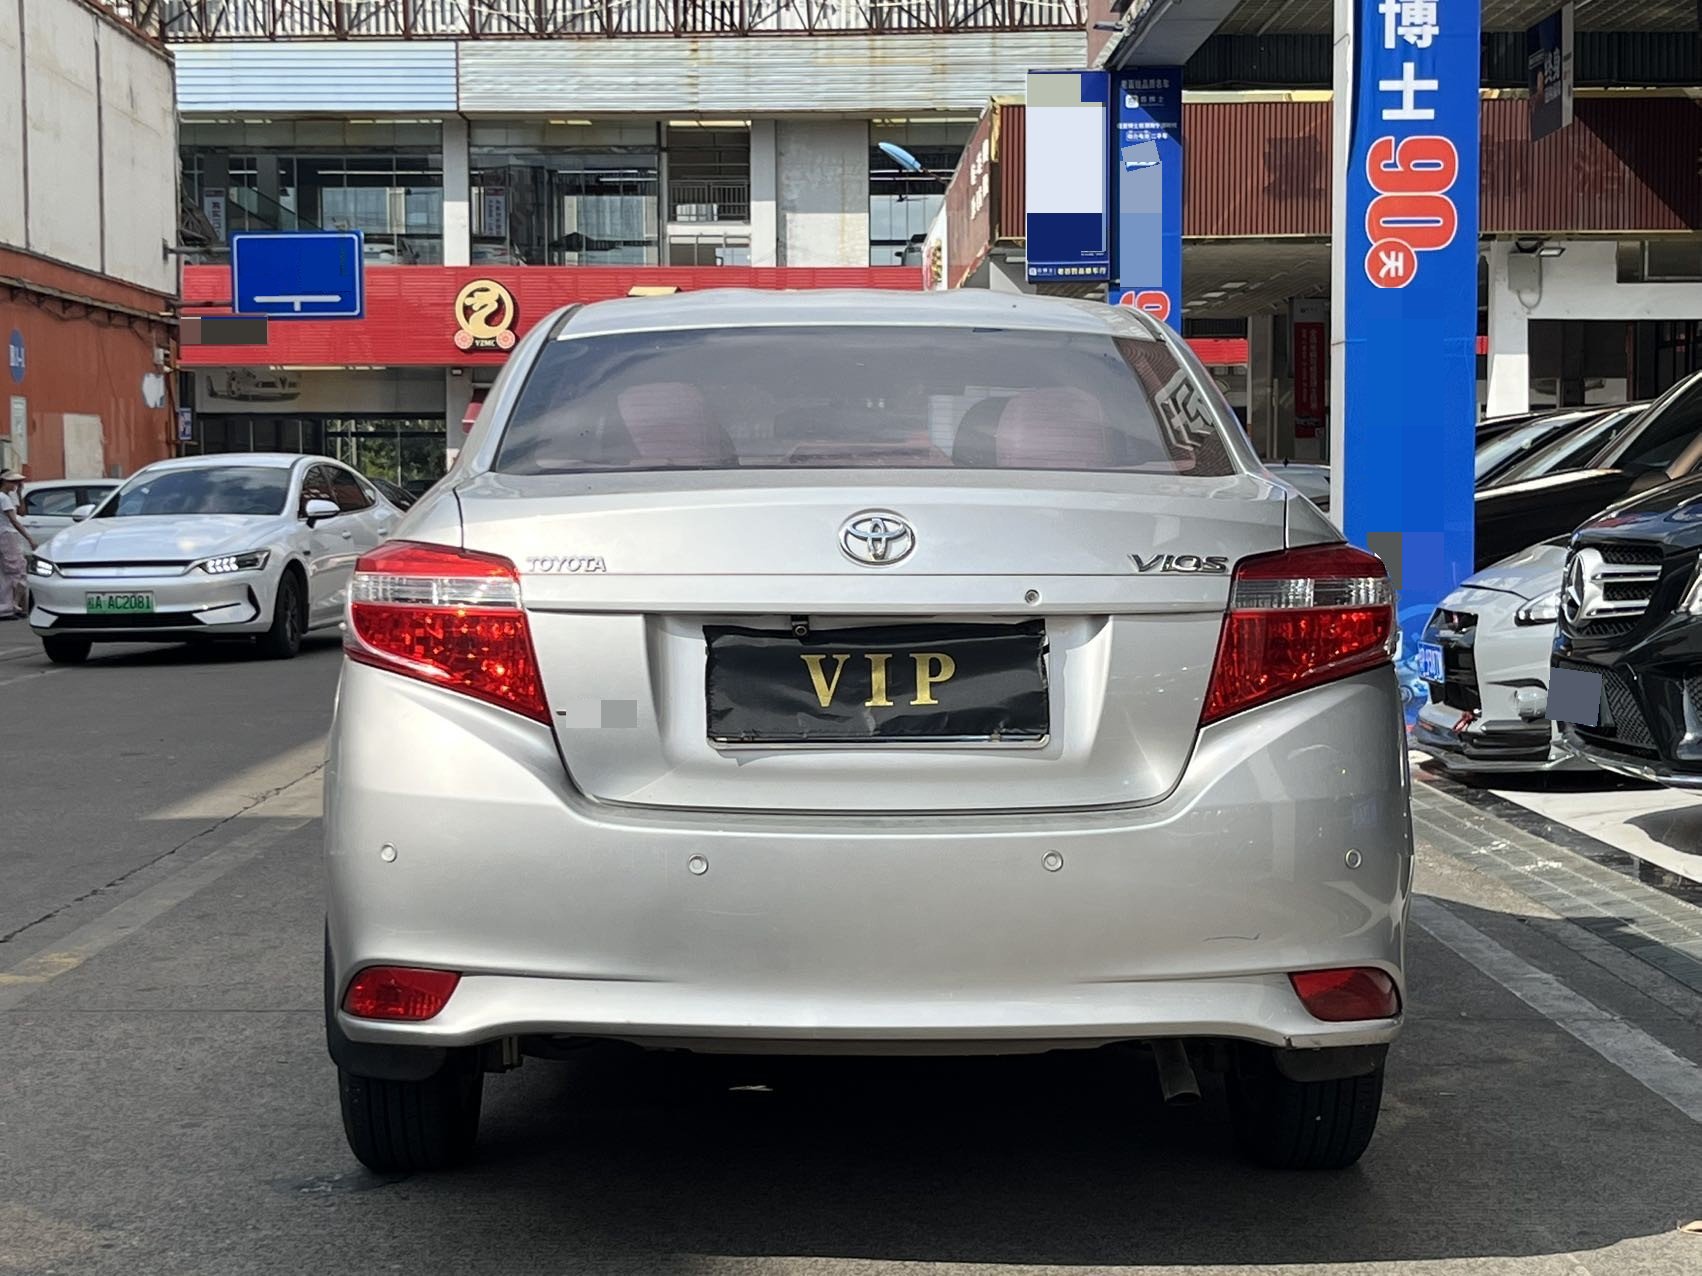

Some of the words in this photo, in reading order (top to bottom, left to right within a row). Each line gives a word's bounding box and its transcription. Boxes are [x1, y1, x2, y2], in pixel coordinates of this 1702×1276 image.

[526, 556, 607, 573] TOYOTA
[1127, 554, 1229, 573] VIOS
[800, 652, 956, 708] VIP
